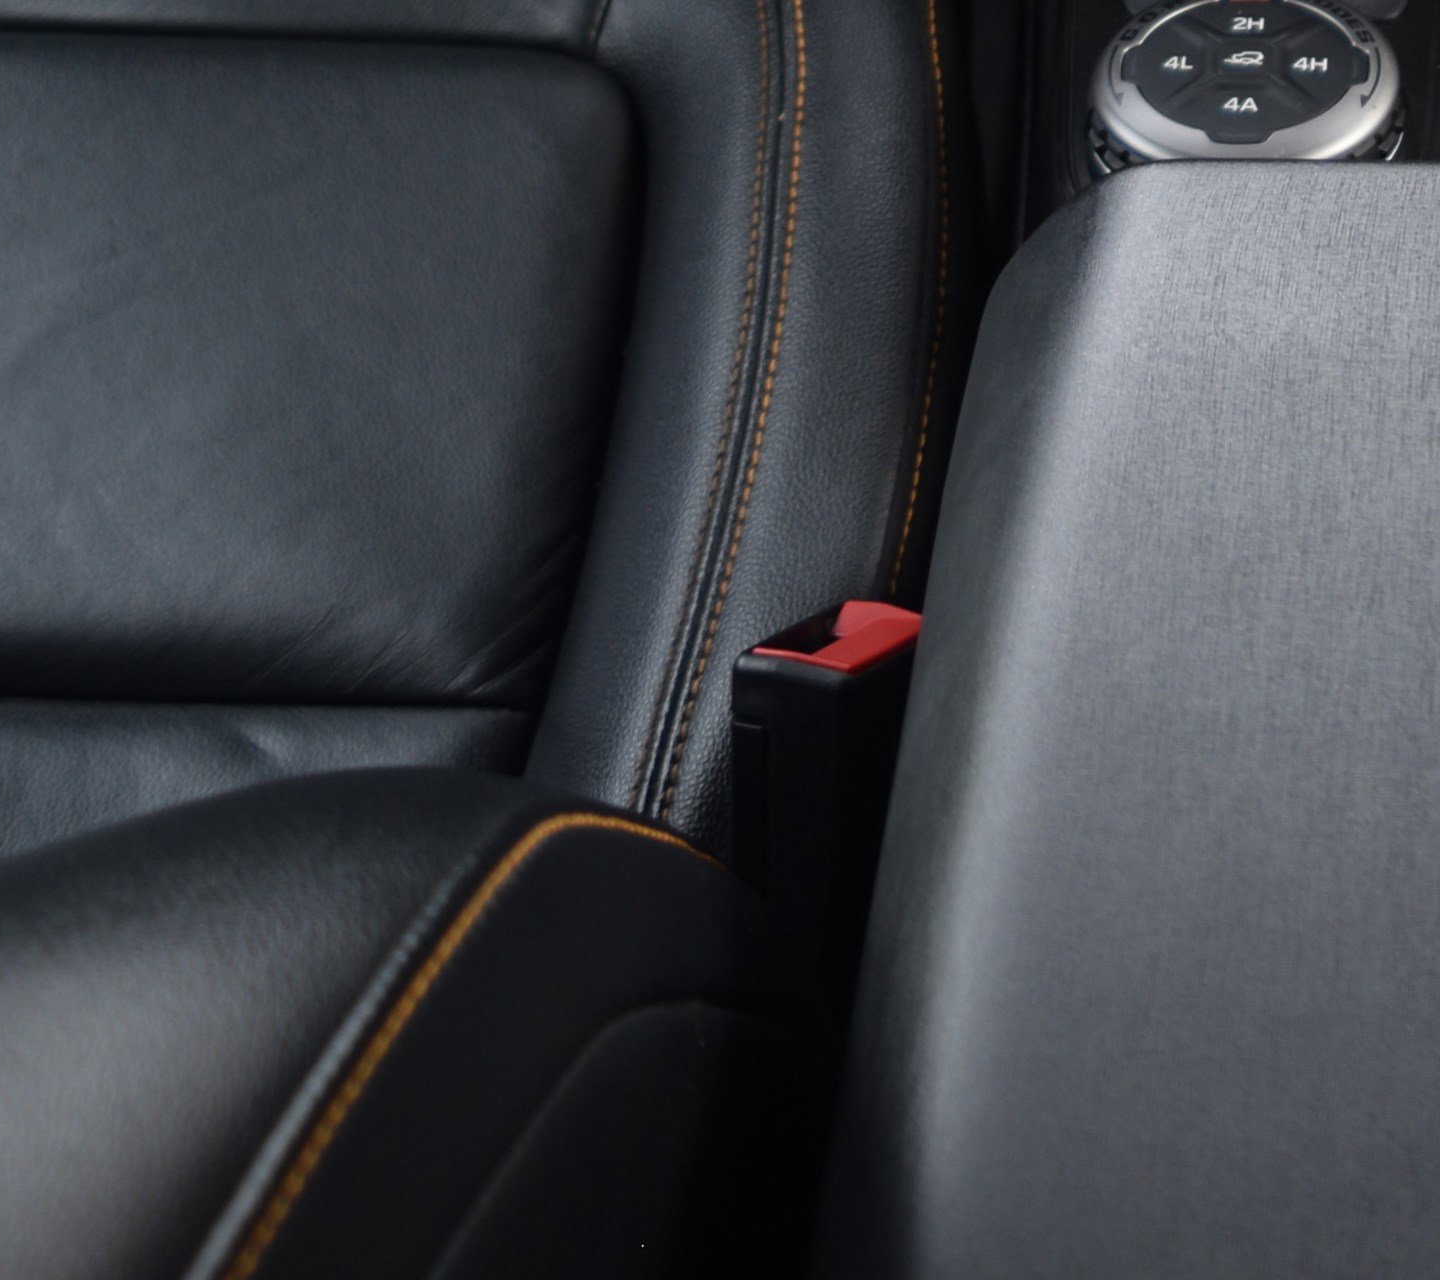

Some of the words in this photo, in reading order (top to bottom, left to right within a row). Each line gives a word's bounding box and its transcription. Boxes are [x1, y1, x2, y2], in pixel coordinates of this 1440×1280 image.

[1232, 16, 1265, 32] 2H
[1163, 55, 1194, 71] 4L
[1291, 56, 1328, 72] 4H
[1222, 96, 1258, 112] 4A
